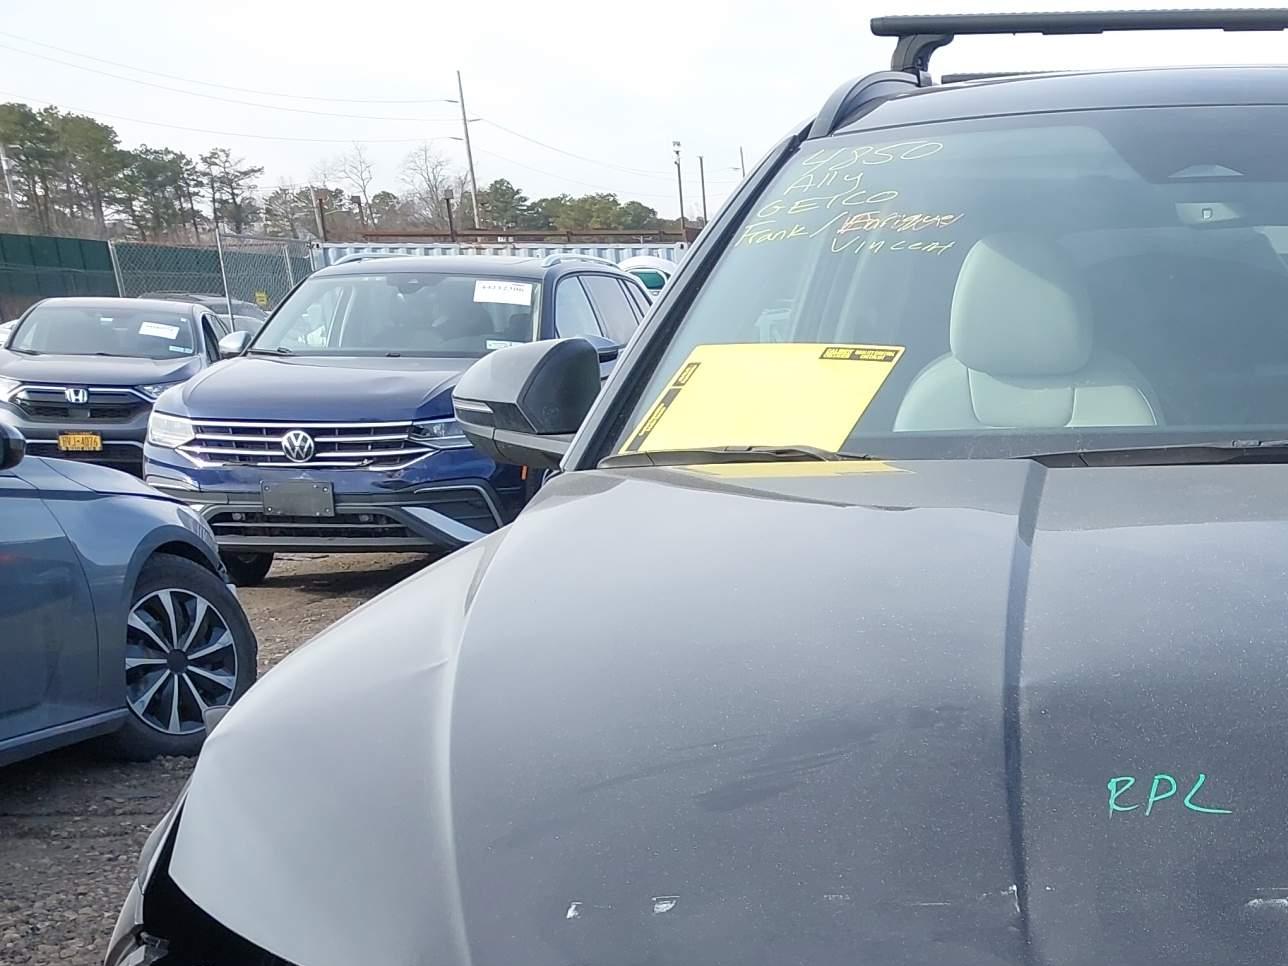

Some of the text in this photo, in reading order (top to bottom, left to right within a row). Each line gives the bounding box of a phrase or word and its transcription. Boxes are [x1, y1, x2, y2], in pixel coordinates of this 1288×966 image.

[784, 171, 864, 196] Ally
[757, 191, 899, 218] GEICO
[1107, 773, 1233, 820] RPL
